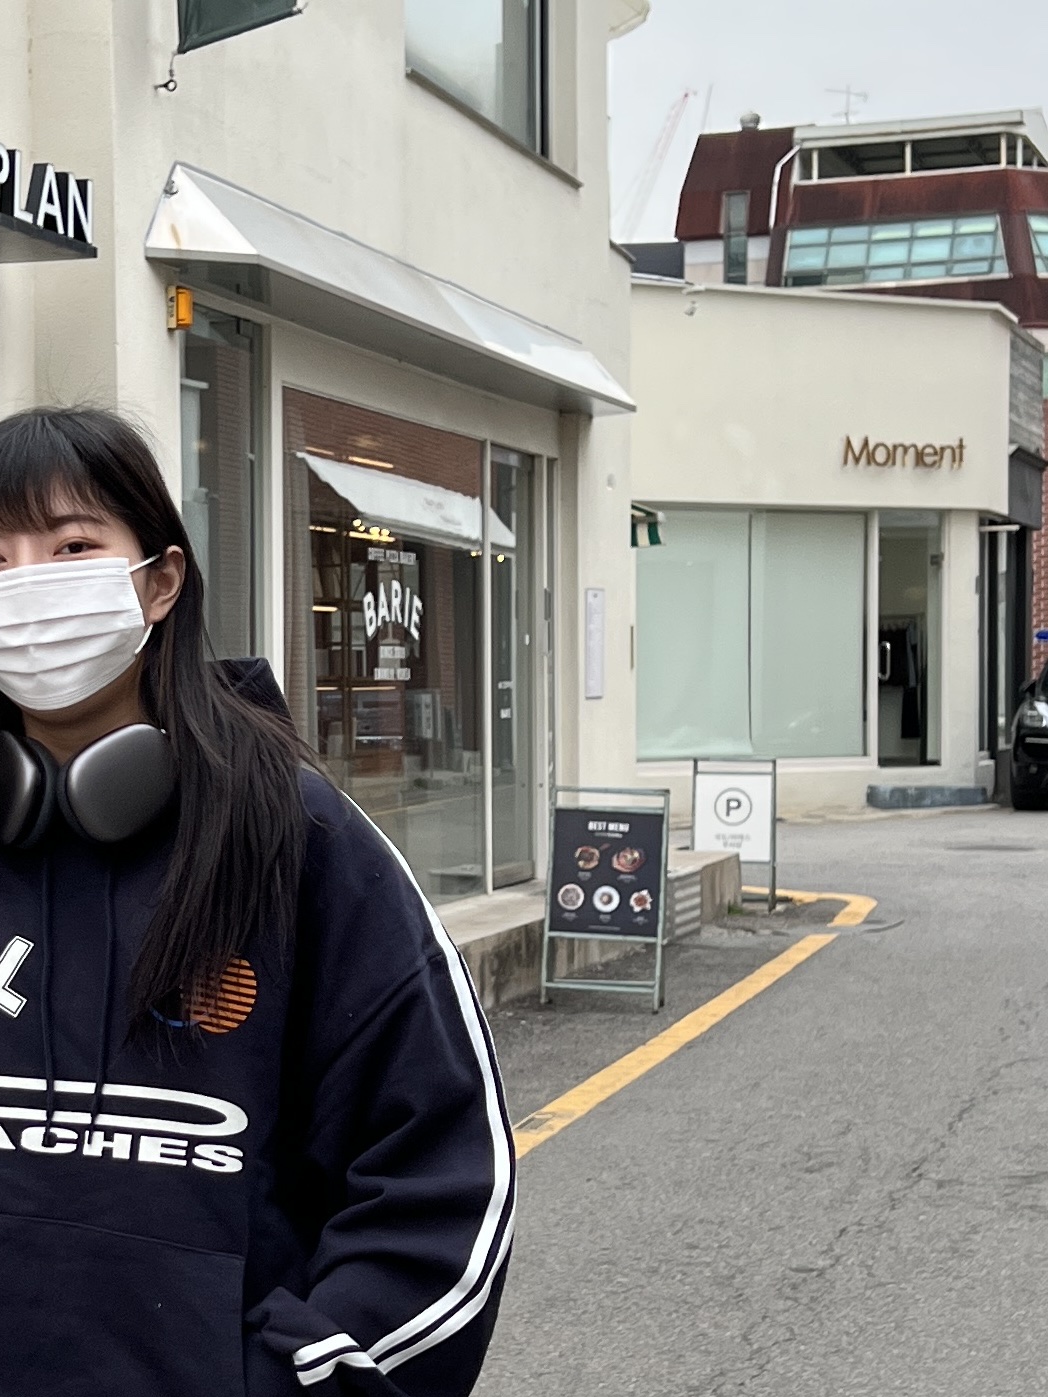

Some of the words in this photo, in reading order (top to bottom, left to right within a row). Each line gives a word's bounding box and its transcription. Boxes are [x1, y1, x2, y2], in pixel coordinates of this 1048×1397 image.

[842, 435, 966, 469] Moment
[363, 580, 423, 641] BARIE
[725, 798, 742, 817] P
